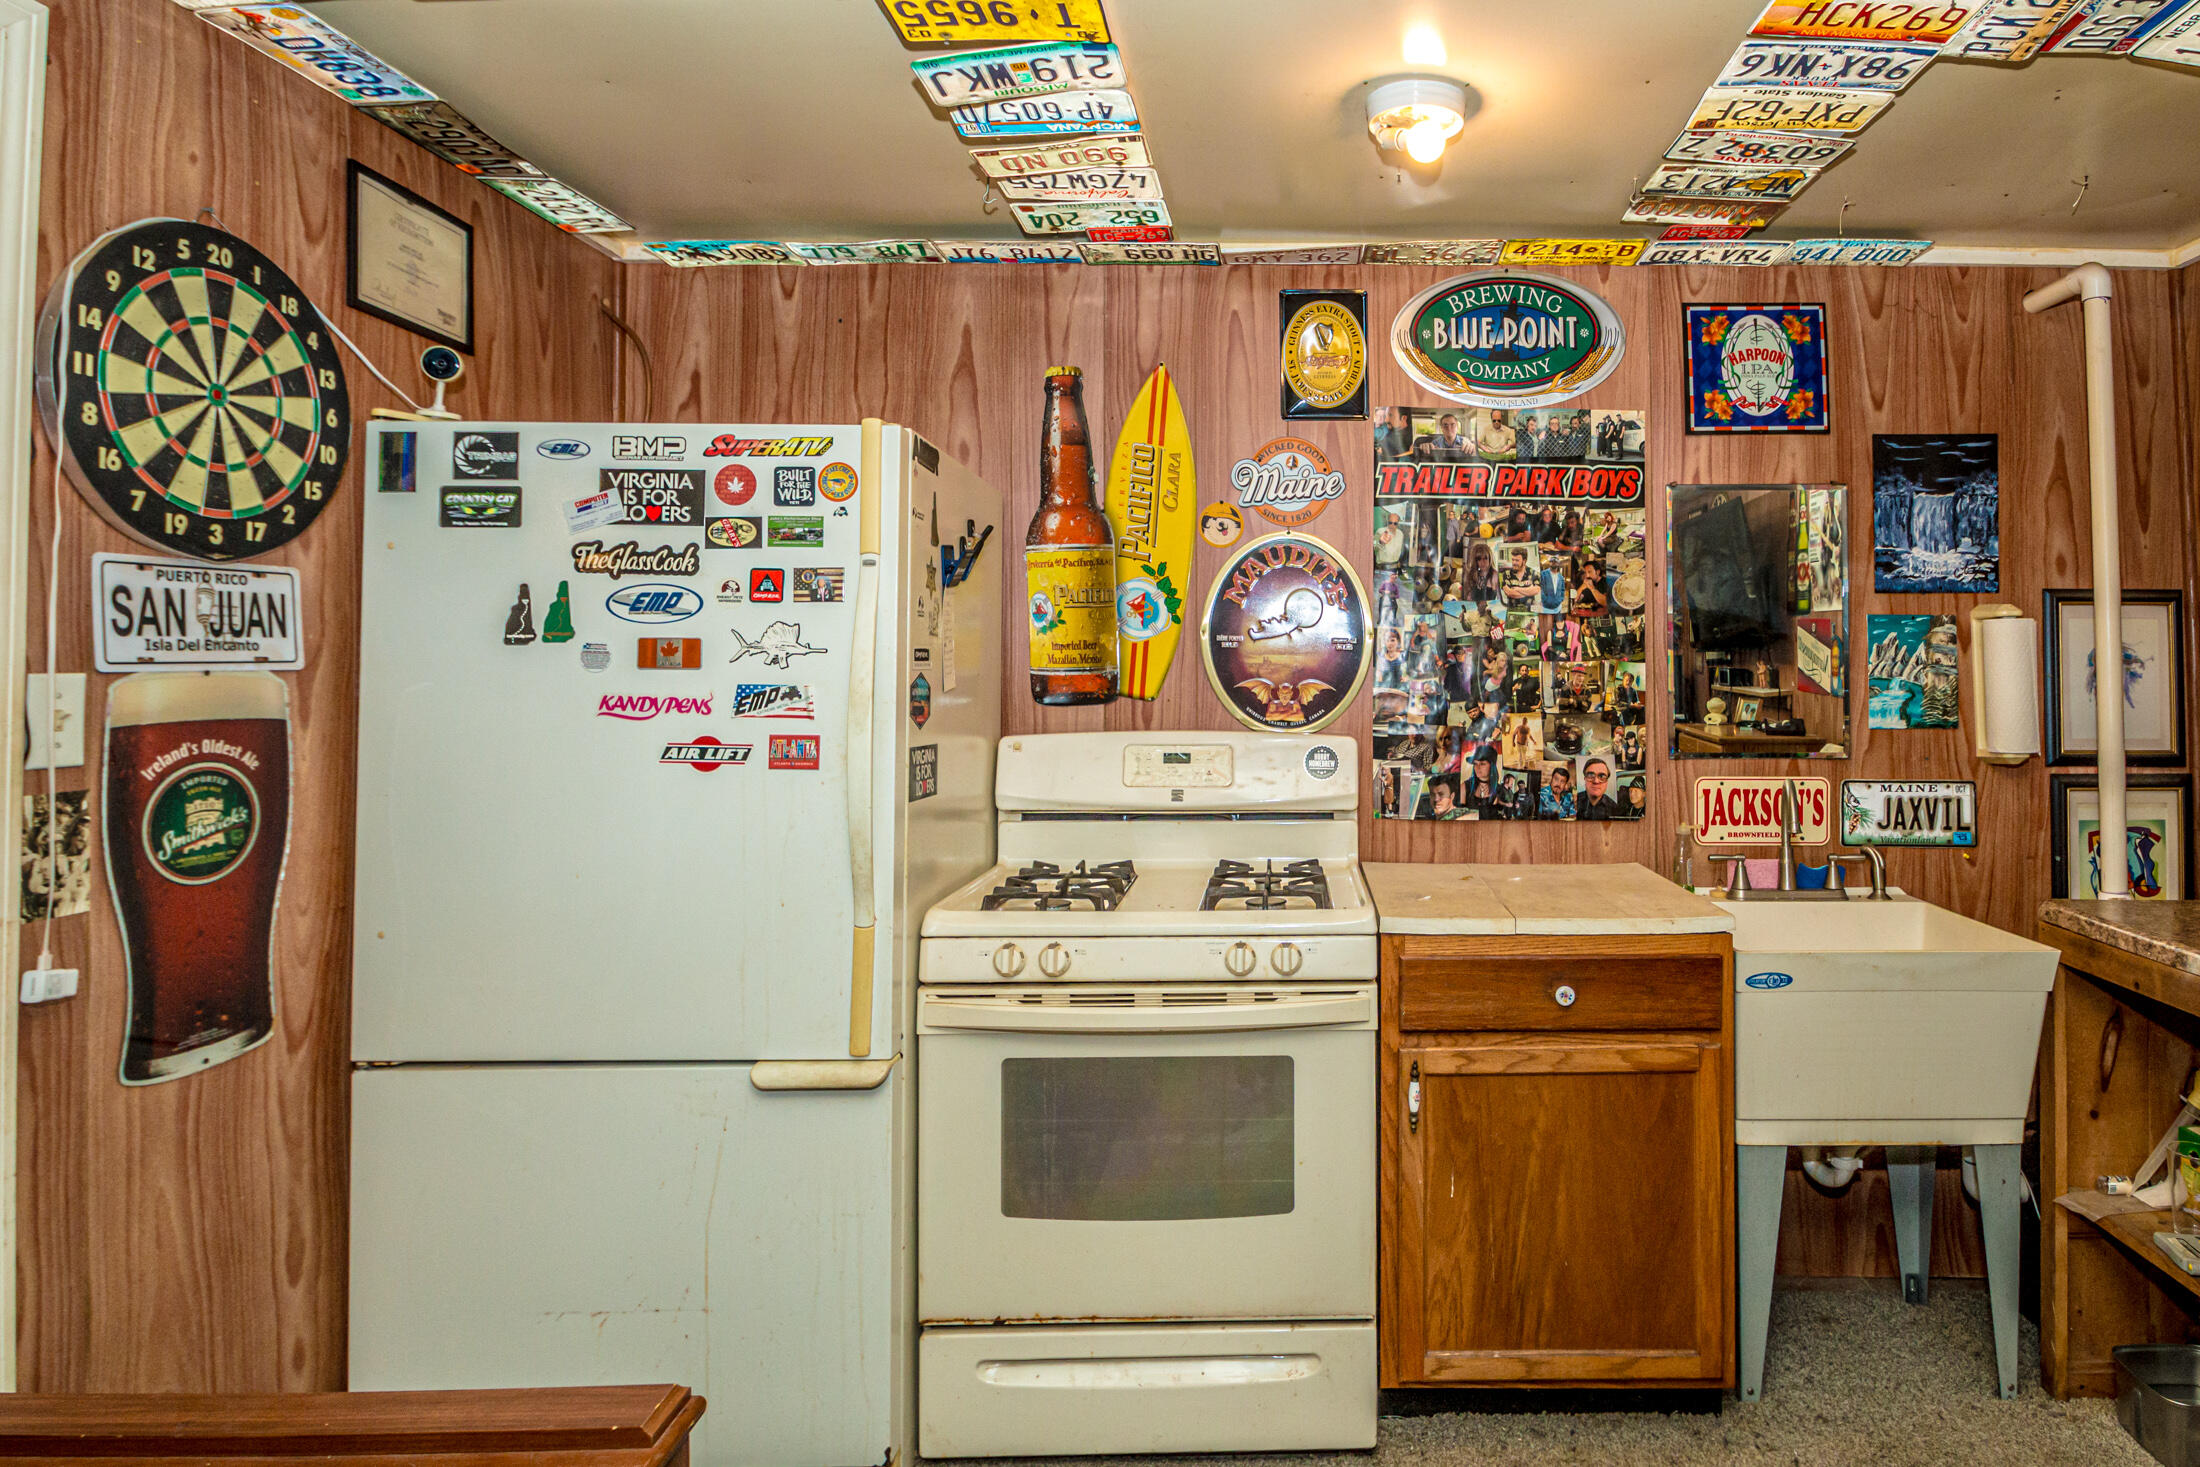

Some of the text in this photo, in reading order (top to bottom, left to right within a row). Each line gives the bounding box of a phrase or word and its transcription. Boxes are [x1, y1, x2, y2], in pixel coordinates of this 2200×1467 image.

[894, 1, 1081, 28] T 9655
[1792, 1, 1969, 33] HCK269
[1829, 30, 1877, 39] MEXICO
[1879, 31, 1902, 40] USA
[1963, 16, 2043, 53] PCK
[929, 53, 1114, 97] 219 WKJ
[1731, 52, 1922, 80] 98X NK6
[993, 81, 1069, 97] MISSOURI
[1779, 80, 1840, 88] TEXAS
[1753, 89, 1848, 99] Garden State
[1046, 122, 1131, 132] MONTANA
[1731, 118, 1821, 128] New Jersey
[998, 146, 1129, 171] 990 ND
[1716, 139, 1837, 161] 60382
[1717, 154, 1784, 165] MAINE
[1006, 172, 1147, 190] 4ZGW755
[1043, 189, 1130, 199] California
[1029, 210, 1161, 229] 652 204
[132, 246, 156, 272] 12
[177, 239, 191, 260] 5
[206, 244, 234, 269] 20
[801, 242, 929, 259] 779 847
[1124, 248, 1216, 261] 660 HG
[1512, 243, 1637, 257] 4214 B
[1717, 249, 1774, 263] VR4
[105, 270, 121, 292] 9
[252, 266, 262, 285] 1
[280, 295, 299, 317] 18
[1446, 284, 1563, 314] BREWING
[78, 305, 102, 331] 14
[1288, 305, 1361, 346] GUINNESS EXTRA STOUT
[307, 331, 319, 350] 4
[1433, 316, 1578, 350] BLUE POINT
[73, 351, 94, 377] 11
[1728, 348, 1787, 366] HARPOON
[1344, 360, 1361, 391] DUBLIN
[1457, 358, 1550, 380] COMPANY
[1741, 363, 1778, 375] I.P.A.
[319, 369, 336, 390] 13
[1482, 398, 1539, 407] LONG ISLAND
[81, 402, 98, 426] 8
[326, 413, 338, 428] 6
[320, 445, 337, 465] 10
[613, 436, 686, 457] BMP
[1256, 442, 1326, 463] WICKED GOOD
[98, 446, 122, 471] 16
[608, 472, 694, 489] VIRGINIA
[777, 469, 813, 481] BUILT
[1162, 452, 1181, 512] CLARA
[1236, 463, 1343, 503] Maine
[1381, 465, 1640, 497] TRAILER PARK BOYS
[304, 481, 322, 500] 15
[445, 494, 494, 505] COUNTRY
[624, 489, 681, 506] IS FOR
[130, 490, 147, 511] 7
[1118, 442, 1155, 563] PACIFICO
[282, 505, 296, 524] 2
[1263, 509, 1312, 523] SINCE 1820
[164, 513, 188, 536] 19
[246, 521, 267, 542] 17
[208, 524, 223, 545] 3
[156, 569, 248, 586] PUERTO RICO
[1223, 544, 1350, 612] MAUDITE
[629, 591, 684, 612] EMP
[112, 585, 287, 638] SAN JUAN
[145, 638, 260, 651] Isla Del Encanto
[1051, 640, 1097, 653] Imported Beer
[734, 686, 781, 716] EMP
[1308, 708, 1326, 721] CANADA
[664, 747, 749, 760] AIR LIFT
[770, 739, 817, 758] ATLANTA
[912, 749, 936, 765] VIRGINIA
[140, 739, 260, 781] Ireland's Oldest Ale
[1308, 760, 1335, 768] HOMEBREW
[916, 763, 932, 779] IS FOR
[180, 775, 229, 789] IMPORTED
[1880, 784, 1938, 793] MAINE
[1955, 786, 1967, 794] OCT
[1877, 797, 1971, 831] JAXVIL
[158, 806, 249, 861] Smithwick's
[1881, 835, 1937, 845] Vacationland
